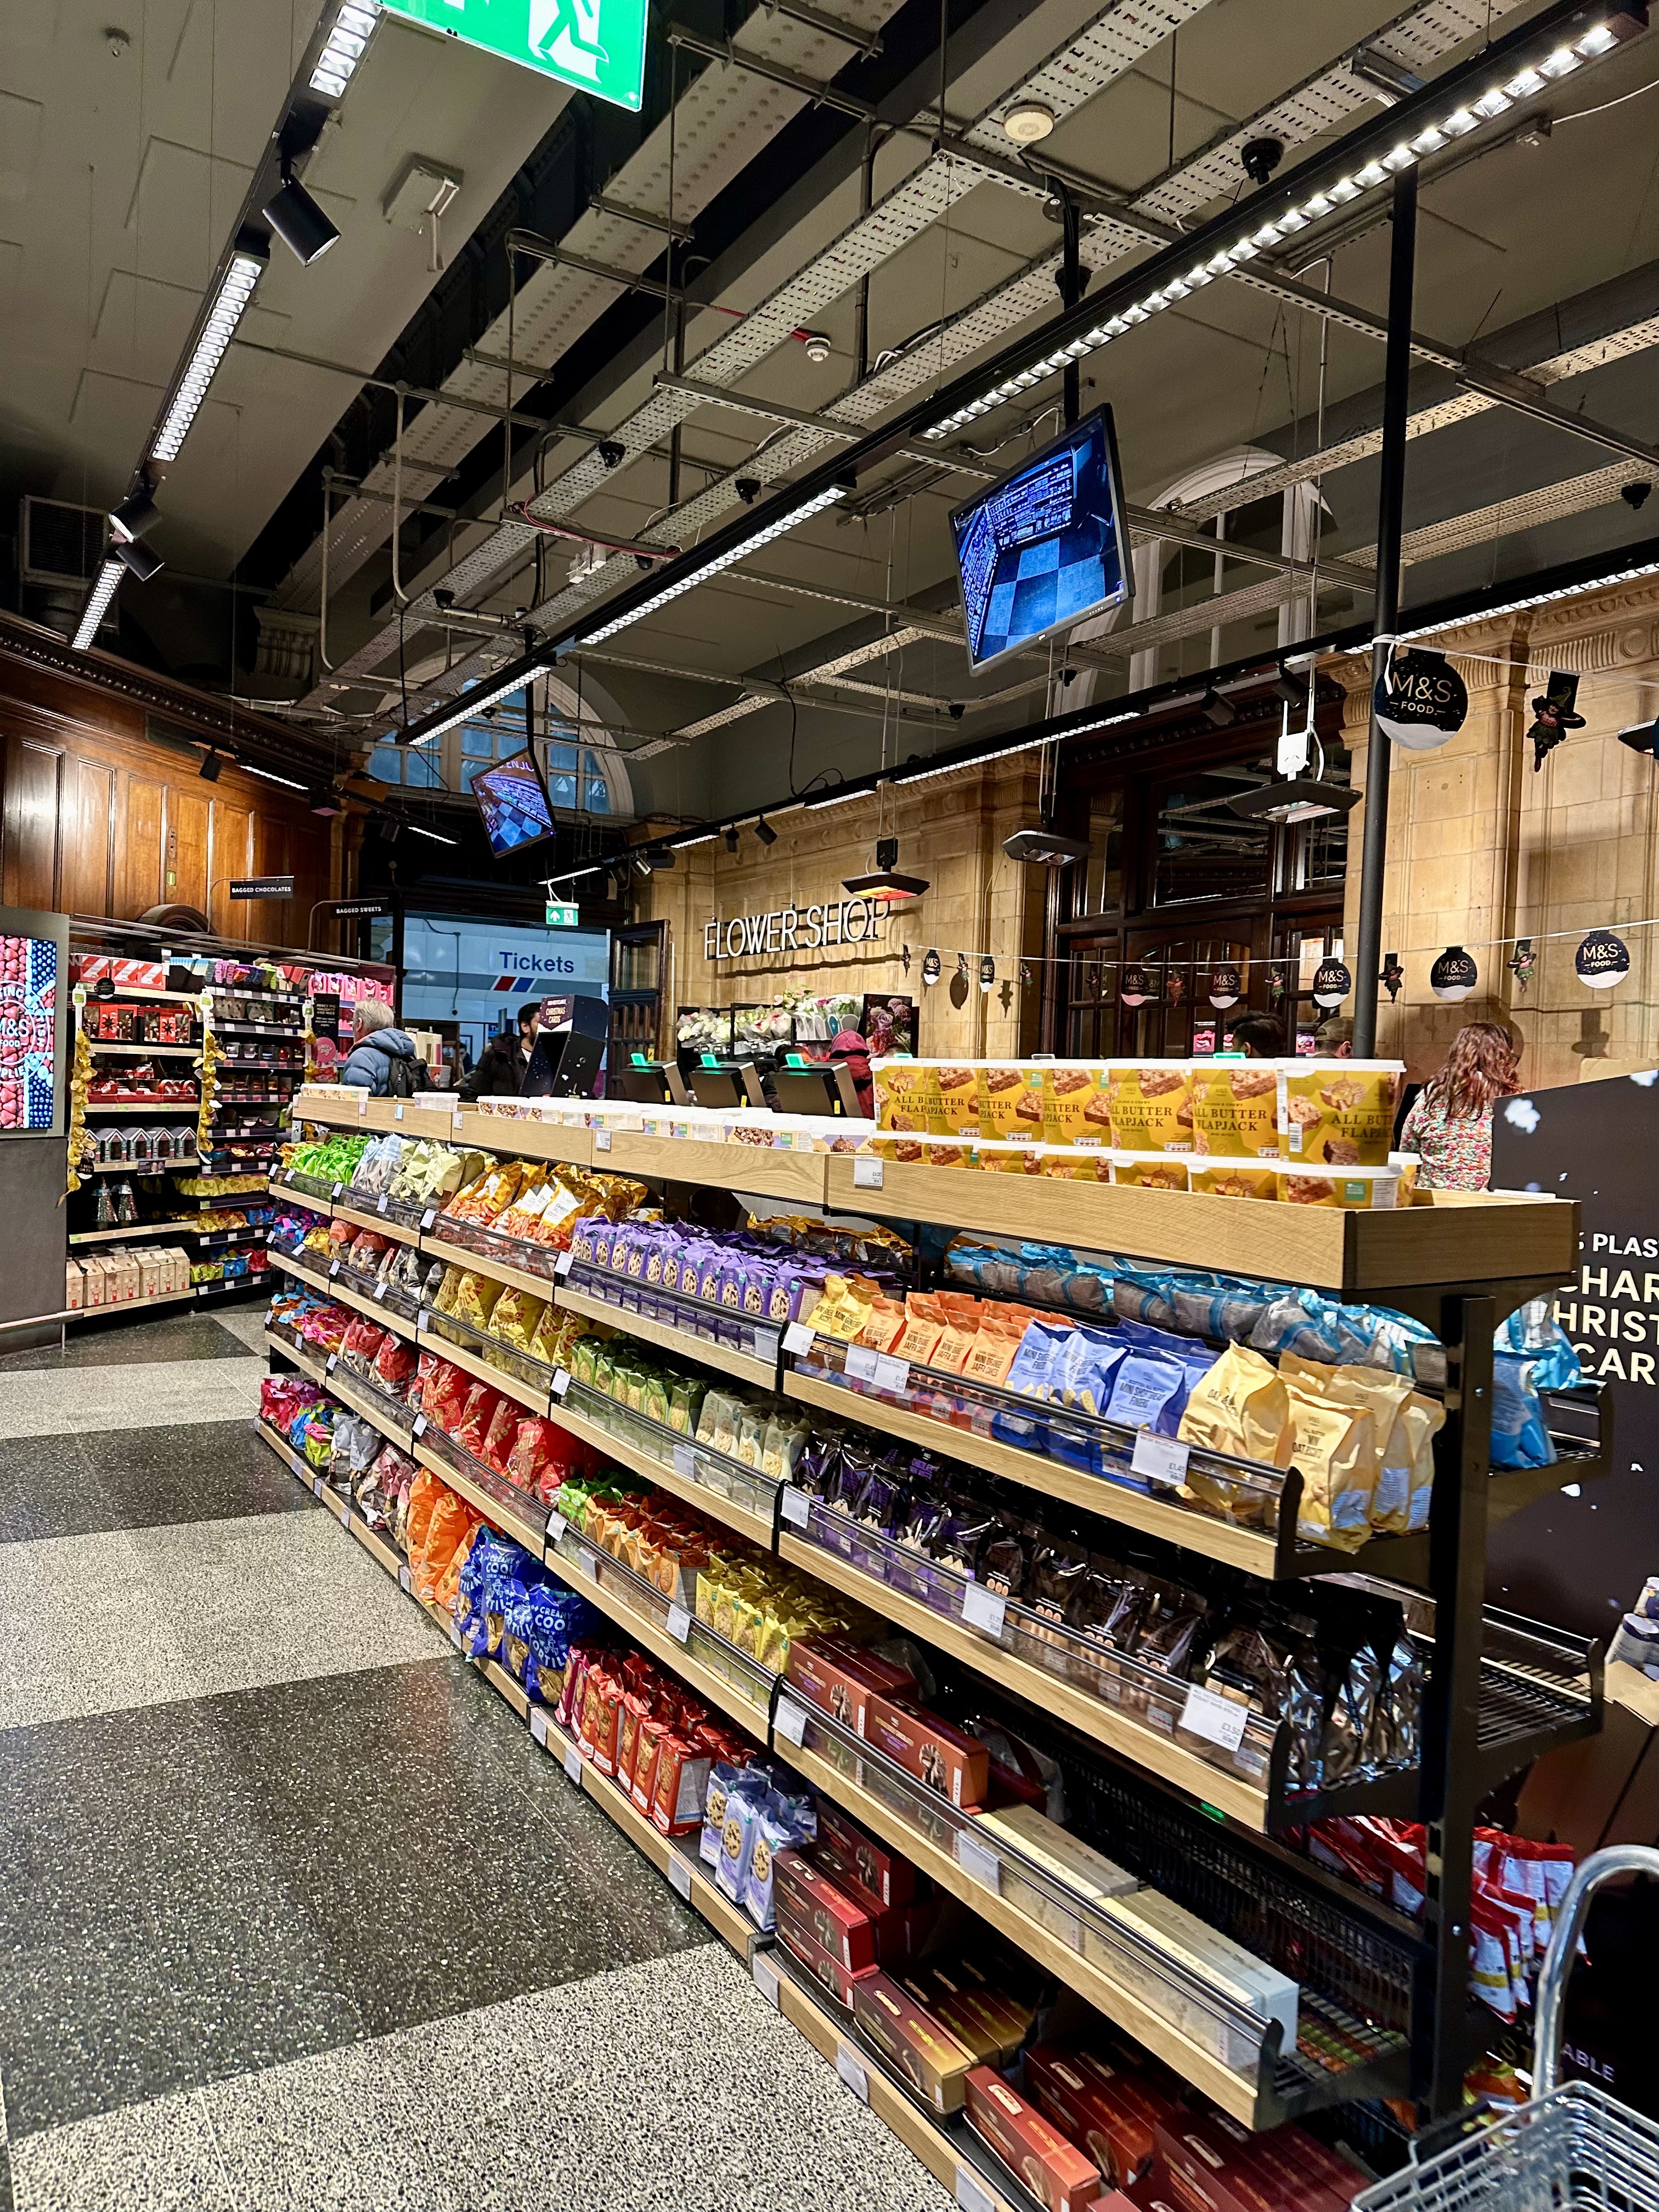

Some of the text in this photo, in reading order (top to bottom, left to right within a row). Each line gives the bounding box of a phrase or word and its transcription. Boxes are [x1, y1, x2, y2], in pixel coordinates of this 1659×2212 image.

[1392, 672, 1452, 703] M&S
[1401, 701, 1434, 714] FOOD
[704, 898, 889, 960] FLOWER SHOP
[1583, 943, 1619, 961] M&S
[499, 951, 574, 973] Tickets
[926, 957, 938, 968] M&S
[1438, 960, 1468, 974] M&S
[1125, 974, 1144, 985] M&S
[1213, 973, 1234, 986] M&S
[1318, 969, 1344, 983] M&S
[894, 1096, 915, 1105] ALL
[928, 1097, 965, 1107] BUTTER
[1110, 1105, 1173, 1116] LL BUTTER
[1211, 1109, 1267, 1119] BUTTER
[1111, 1116, 1164, 1127] FLAPJACK
[1197, 1119, 1258, 1131] FLAPJACK
[1330, 1114, 1362, 1124] ALL
[1593, 1233, 1659, 1259] PLAS
[1558, 1265, 1659, 1304] HAR
[1553, 1300, 1659, 1345] HRIS
[486, 1562, 514, 1576] COOL
[534, 1614, 573, 1632] COOL
